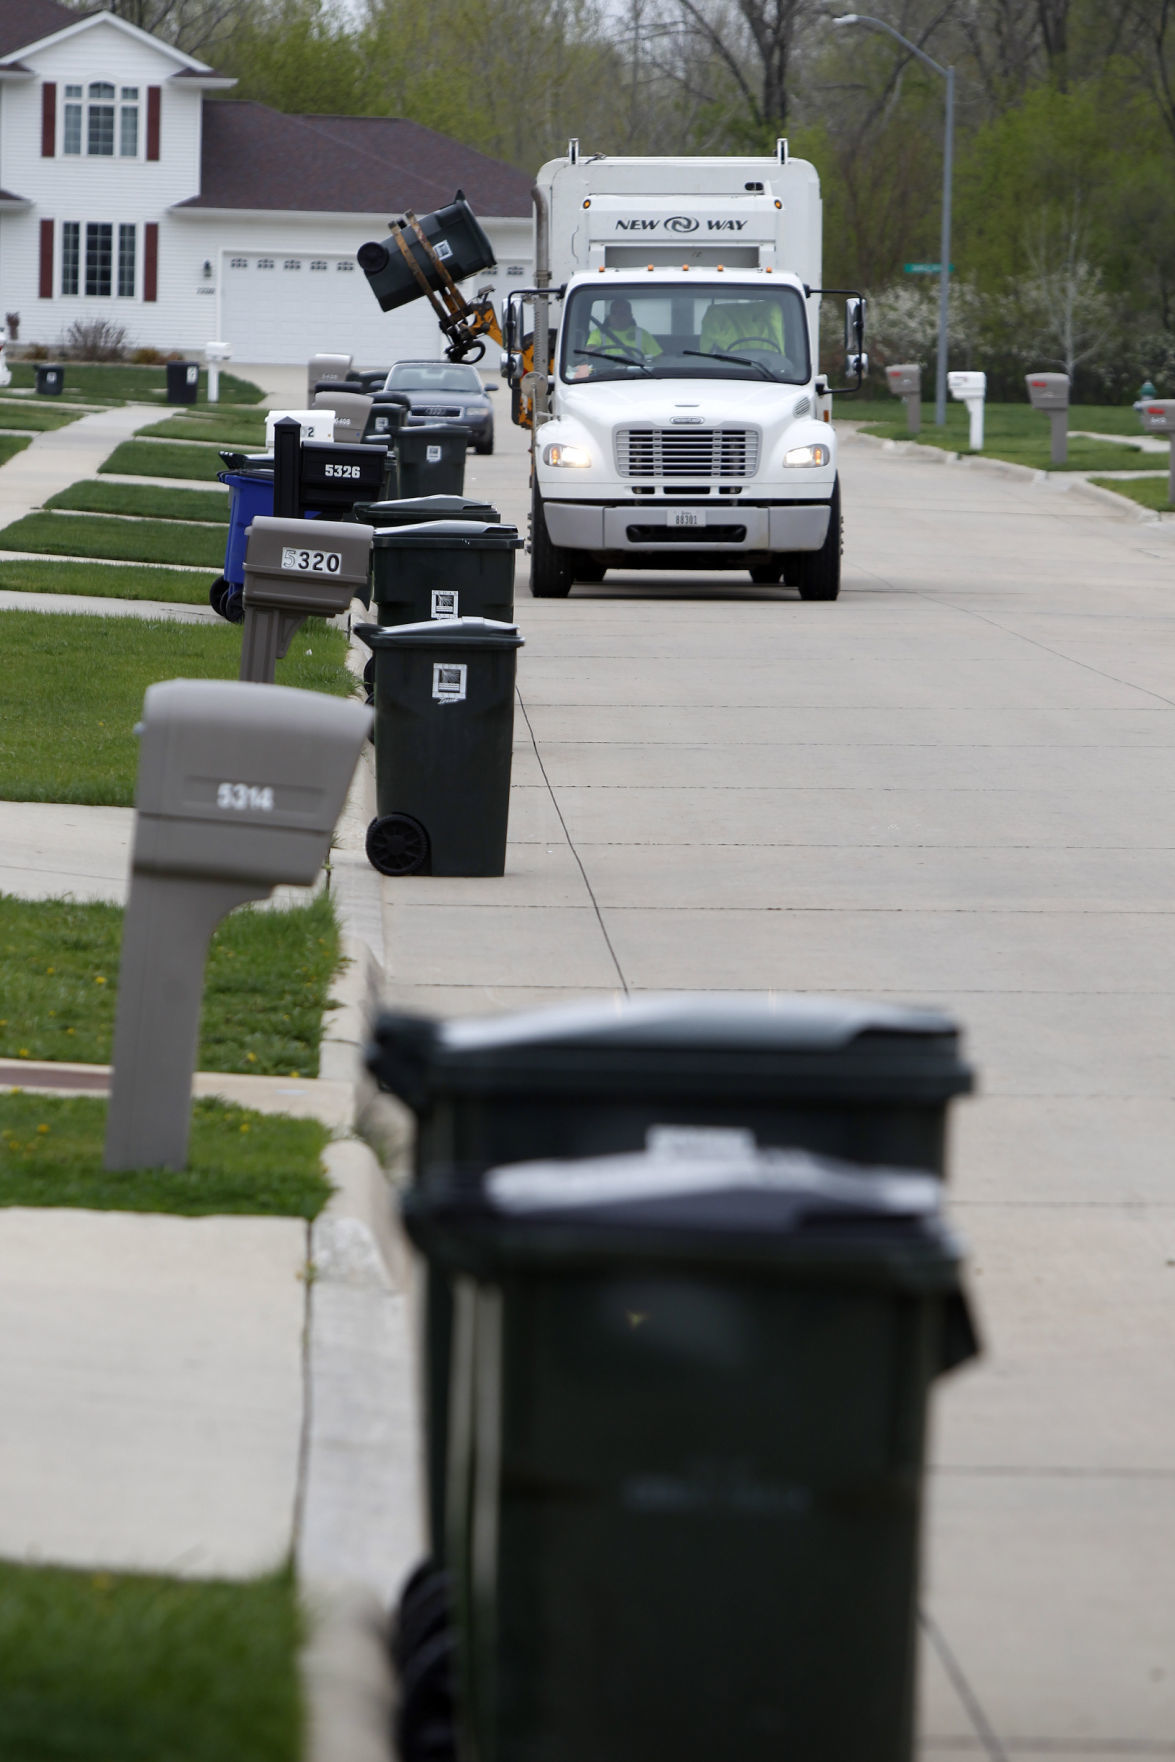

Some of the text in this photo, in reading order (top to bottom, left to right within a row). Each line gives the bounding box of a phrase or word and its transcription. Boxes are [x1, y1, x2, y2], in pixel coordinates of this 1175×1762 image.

[615, 219, 661, 231] NEW
[706, 219, 748, 231] WAY
[324, 463, 361, 479] 5326
[282, 549, 340, 573] 5320
[217, 782, 274, 813] 5314
